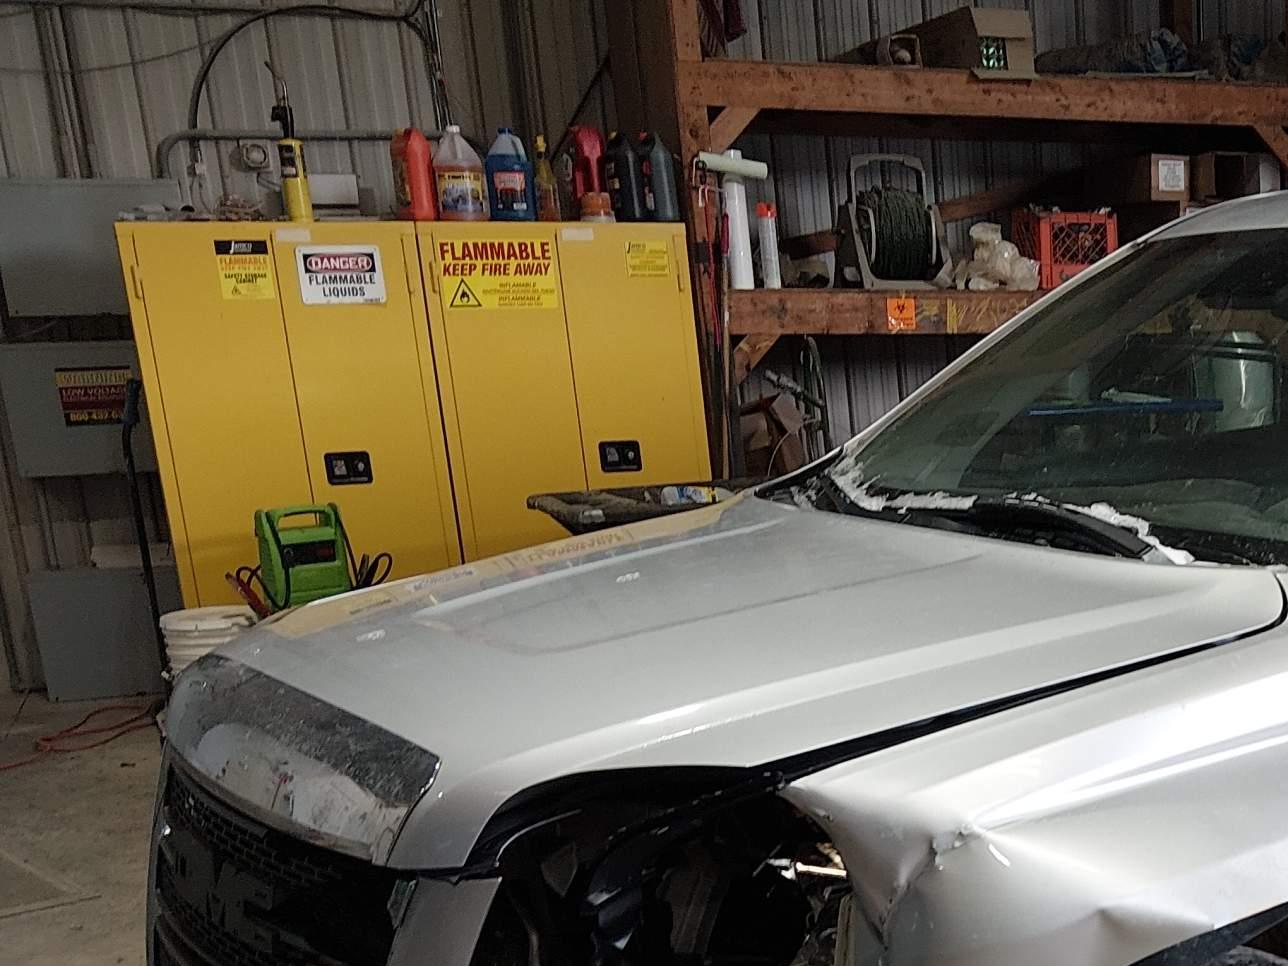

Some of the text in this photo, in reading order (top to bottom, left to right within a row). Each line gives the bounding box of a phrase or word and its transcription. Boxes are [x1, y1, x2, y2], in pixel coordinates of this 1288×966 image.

[439, 241, 552, 261] FLAMMABLE
[311, 256, 368, 270] DANGER
[442, 262, 551, 277] KEEP FIRE AWAY
[308, 273, 376, 286] FLAMMABLE
[322, 285, 366, 298] LIQUIDS
